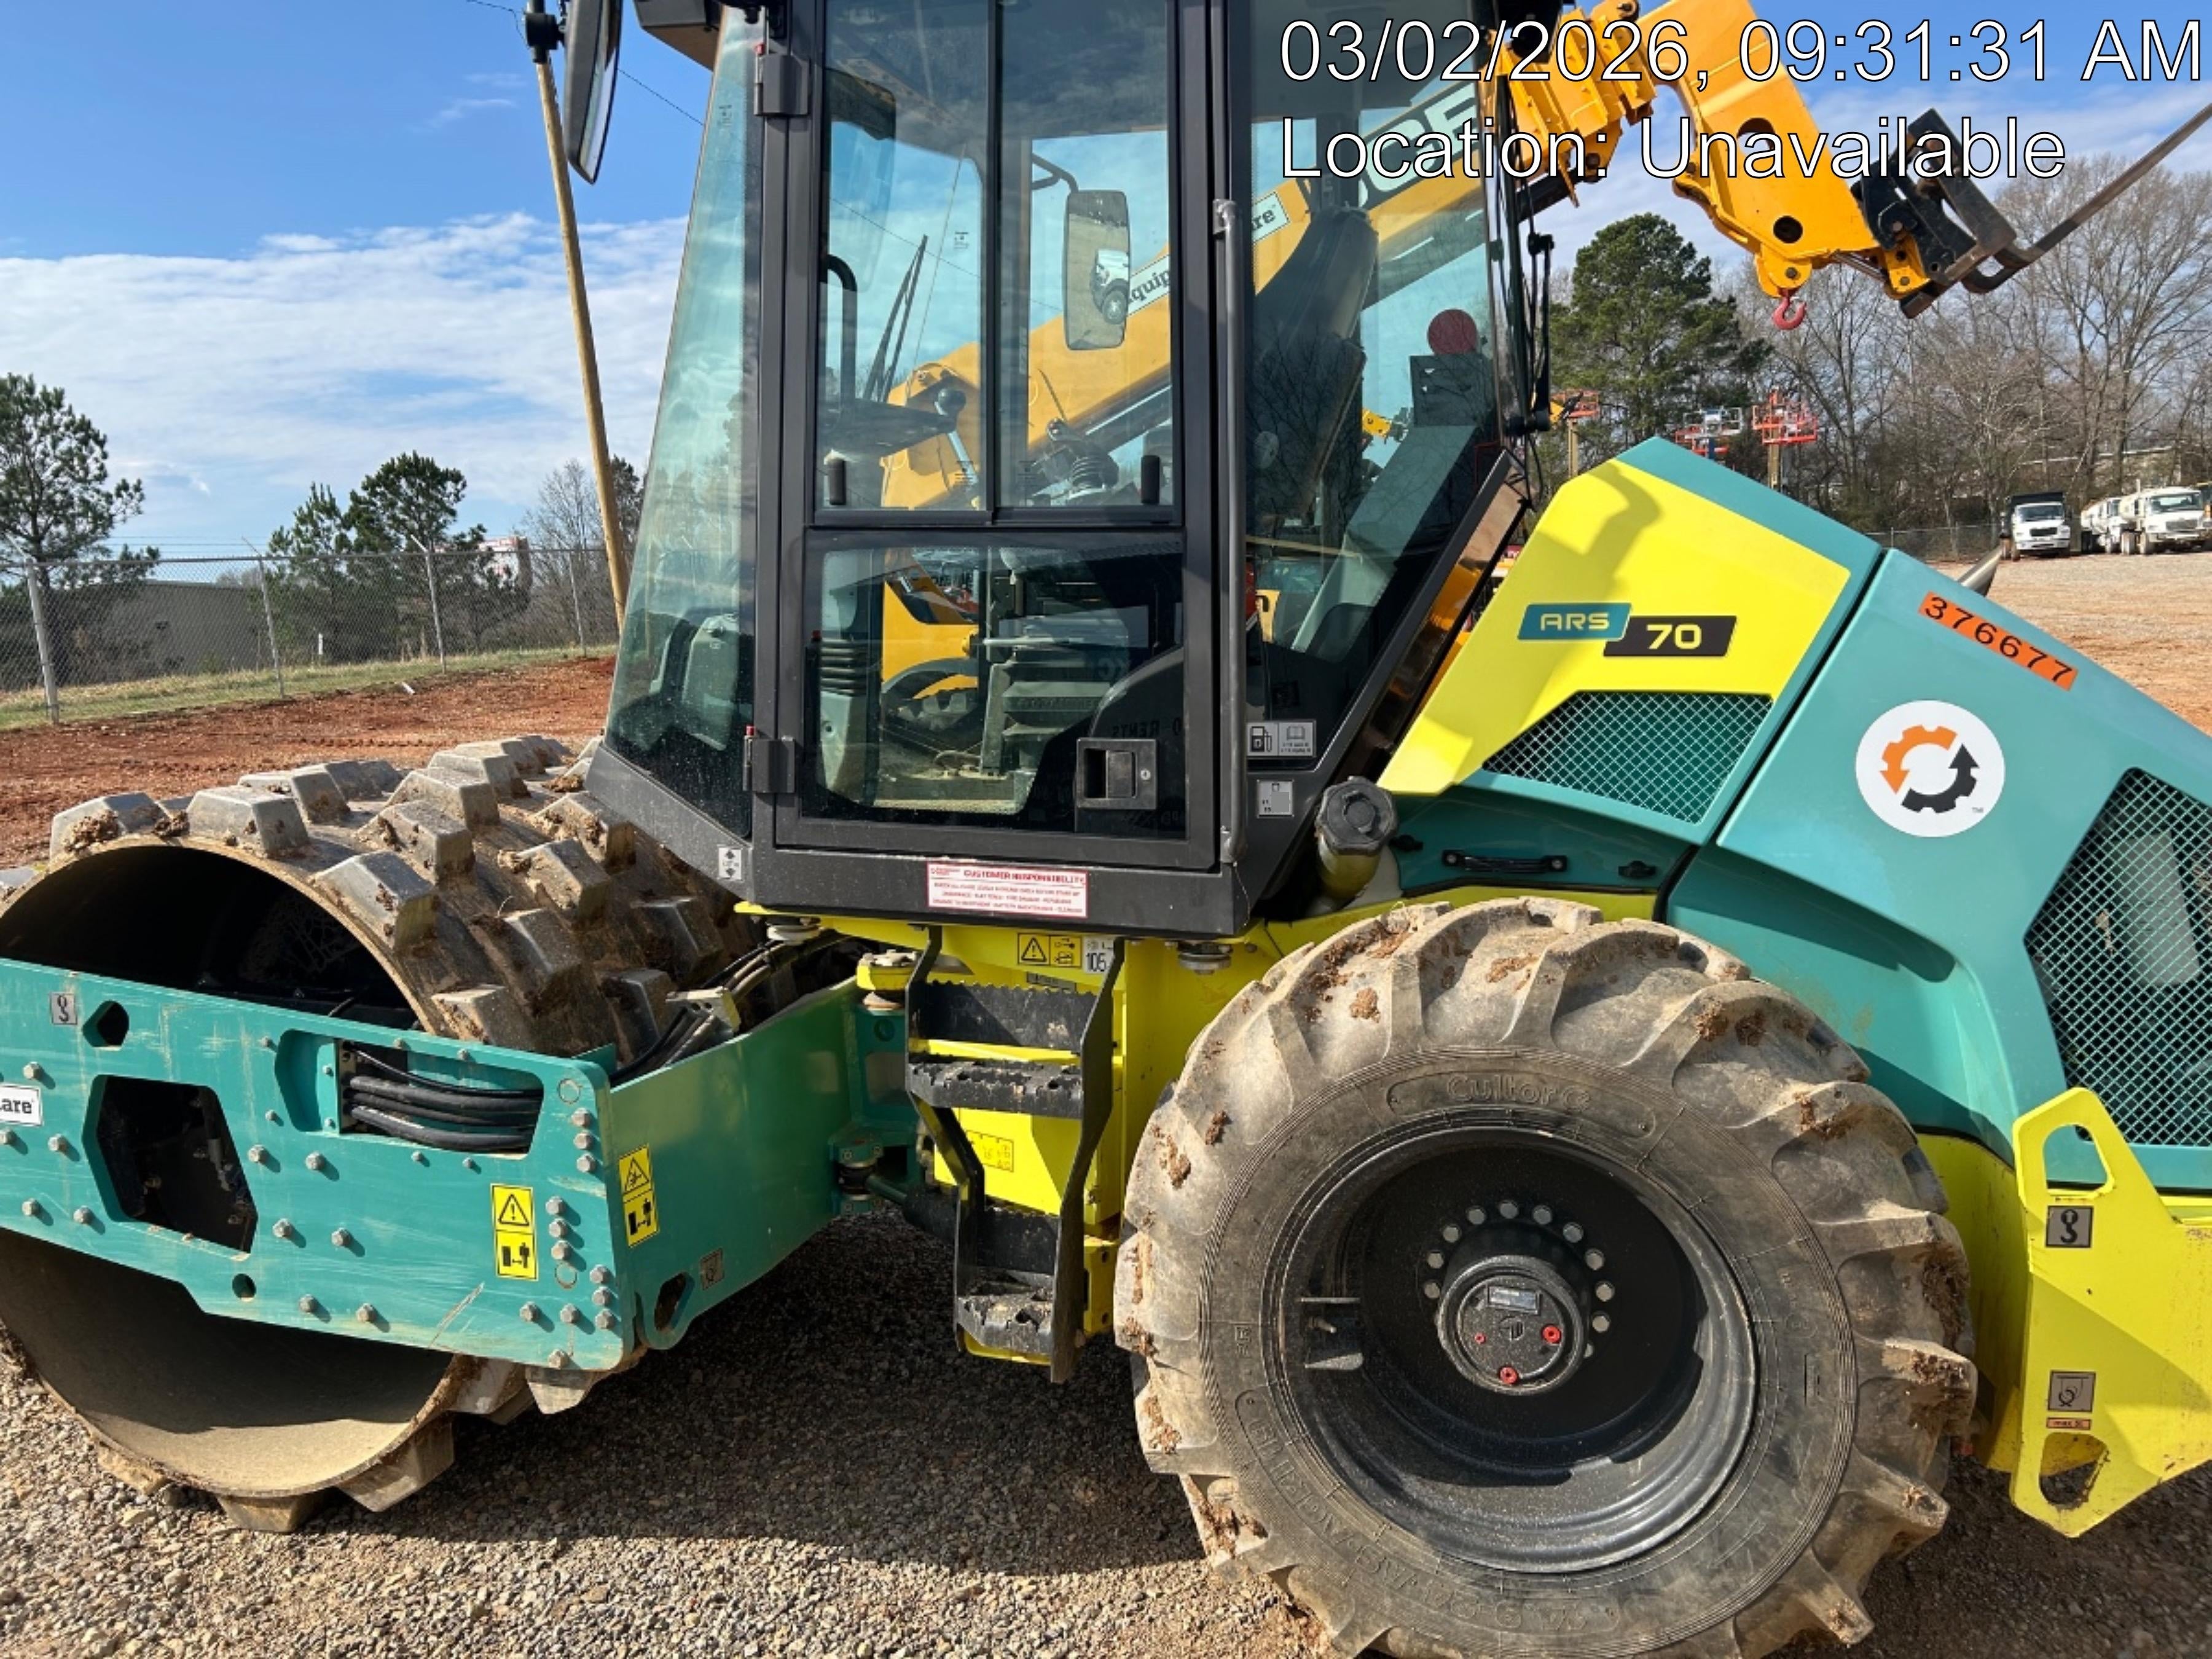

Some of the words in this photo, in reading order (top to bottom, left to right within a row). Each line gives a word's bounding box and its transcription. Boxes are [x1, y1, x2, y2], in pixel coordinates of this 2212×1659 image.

[1540, 613, 1610, 631] ARS
[1646, 624, 1702, 650] 70
[1924, 596, 2073, 683] 376677
[963, 869, 1011, 880] CUSTOMER
[0, 1097, 33, 1114] are
